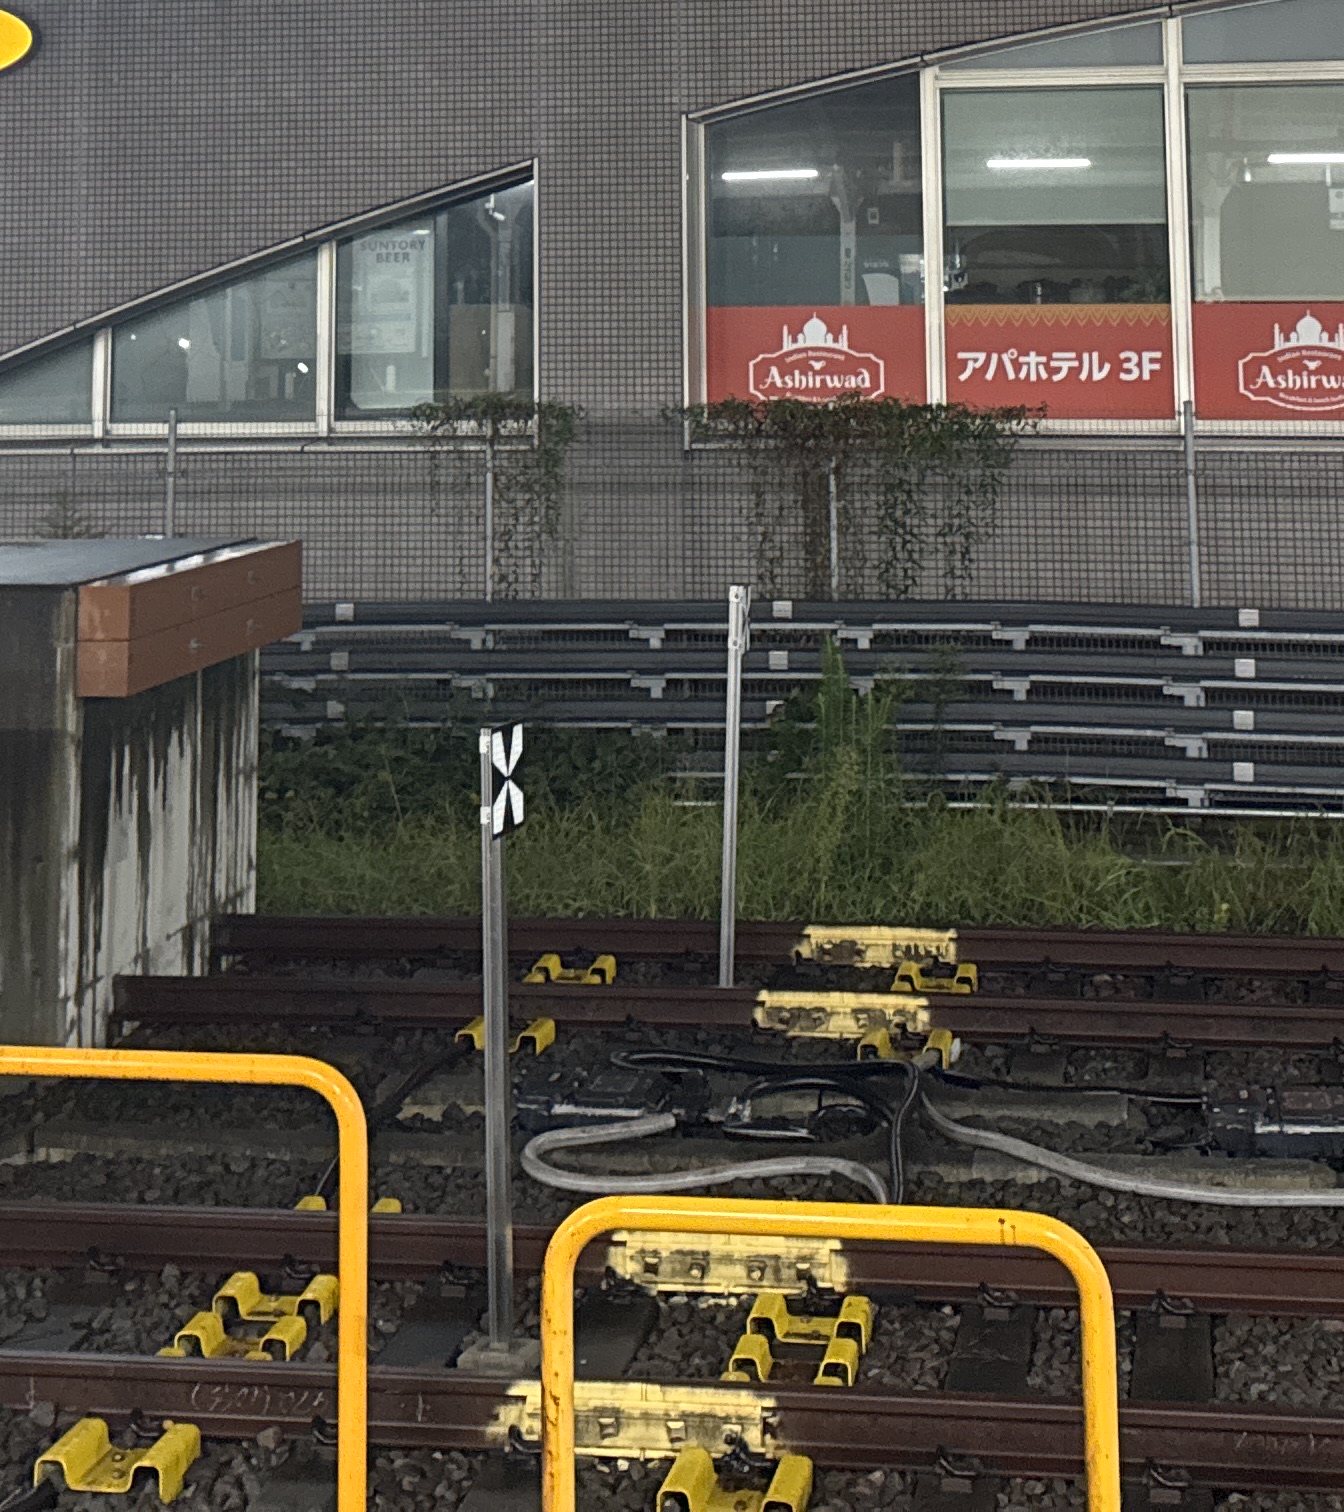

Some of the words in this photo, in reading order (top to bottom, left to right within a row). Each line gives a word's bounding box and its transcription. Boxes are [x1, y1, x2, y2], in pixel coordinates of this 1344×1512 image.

[360, 239, 426, 252] SUNTORY
[376, 251, 411, 264] BEER
[957, 348, 1111, 382] アパホテル
[1119, 350, 1162, 381] 3F
[759, 364, 871, 390] Ashirwad
